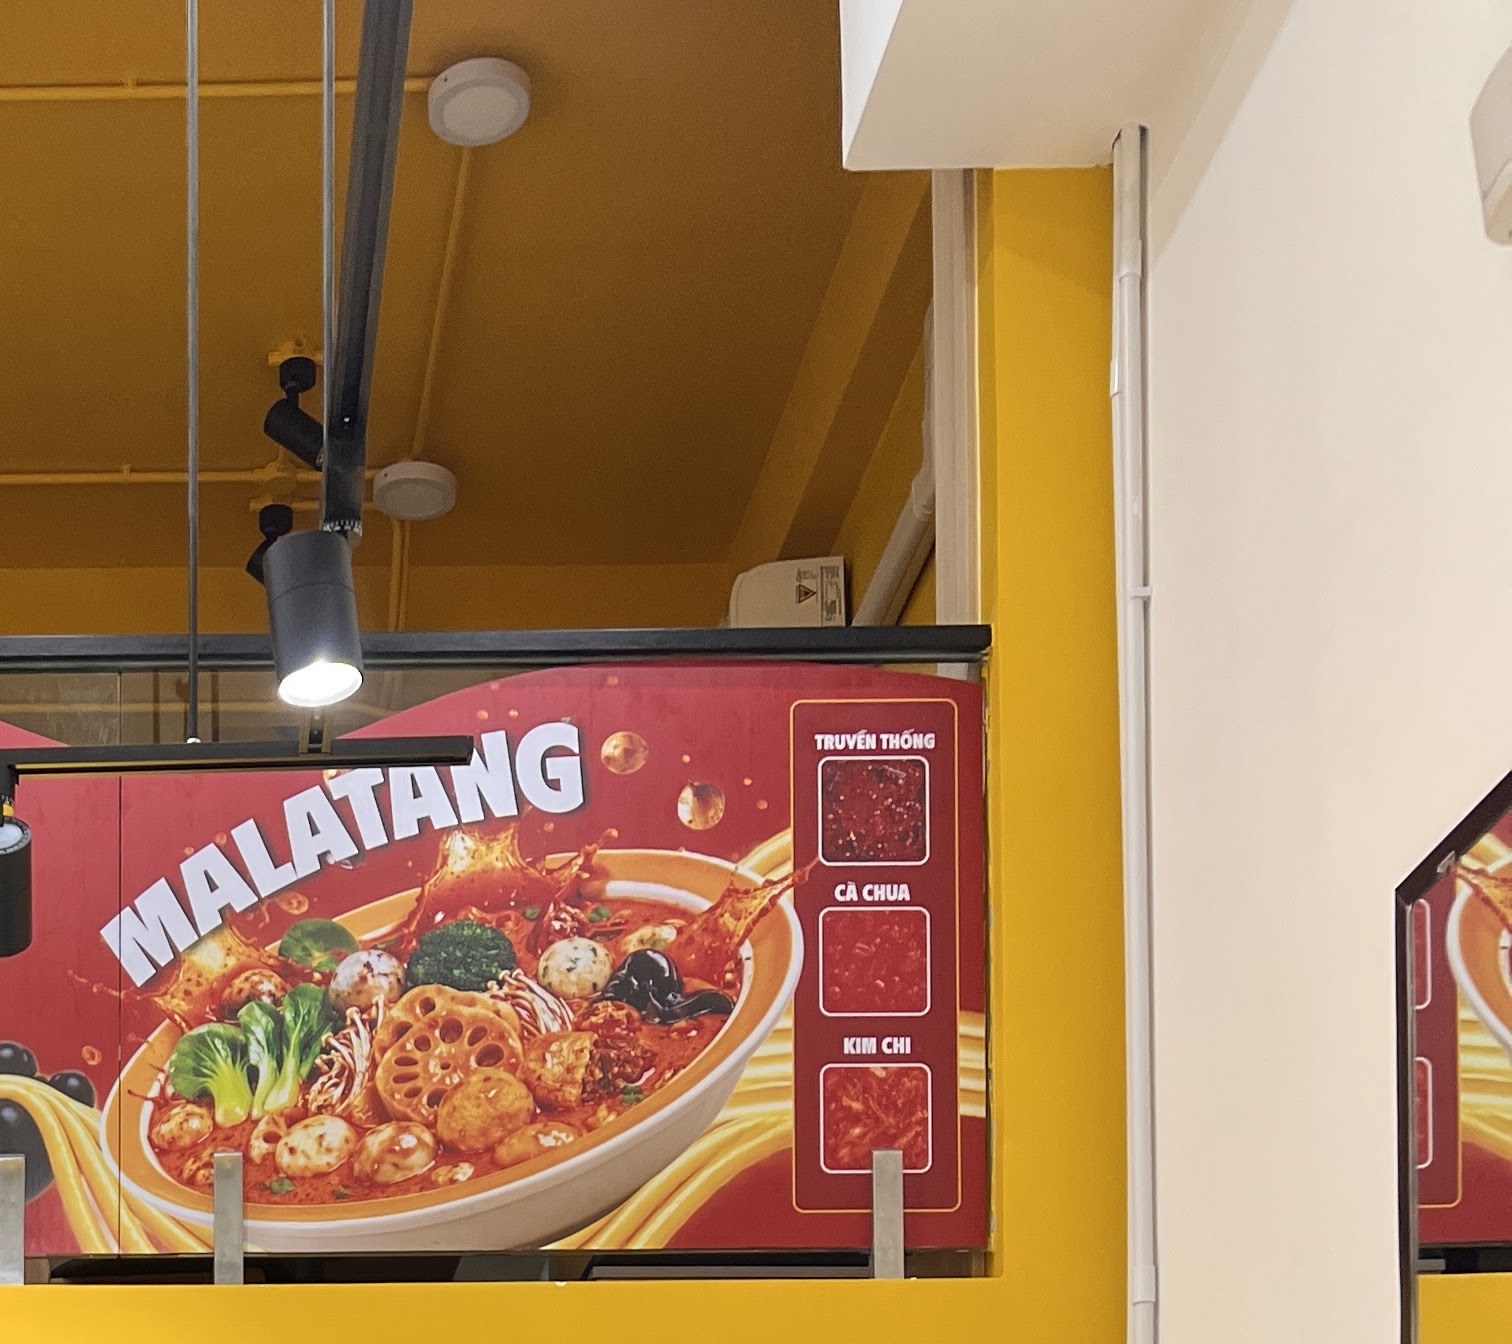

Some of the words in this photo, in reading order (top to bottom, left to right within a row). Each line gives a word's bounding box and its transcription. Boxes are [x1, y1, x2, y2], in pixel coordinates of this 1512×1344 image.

[814, 729, 877, 750] TRUYỀN
[880, 728, 936, 750] THỐNG
[99, 721, 584, 988] MALATANG
[834, 881, 859, 902] CÀ
[862, 883, 911, 902] CHUA
[843, 1037, 877, 1055] KIM
[881, 1036, 912, 1055] CHI
